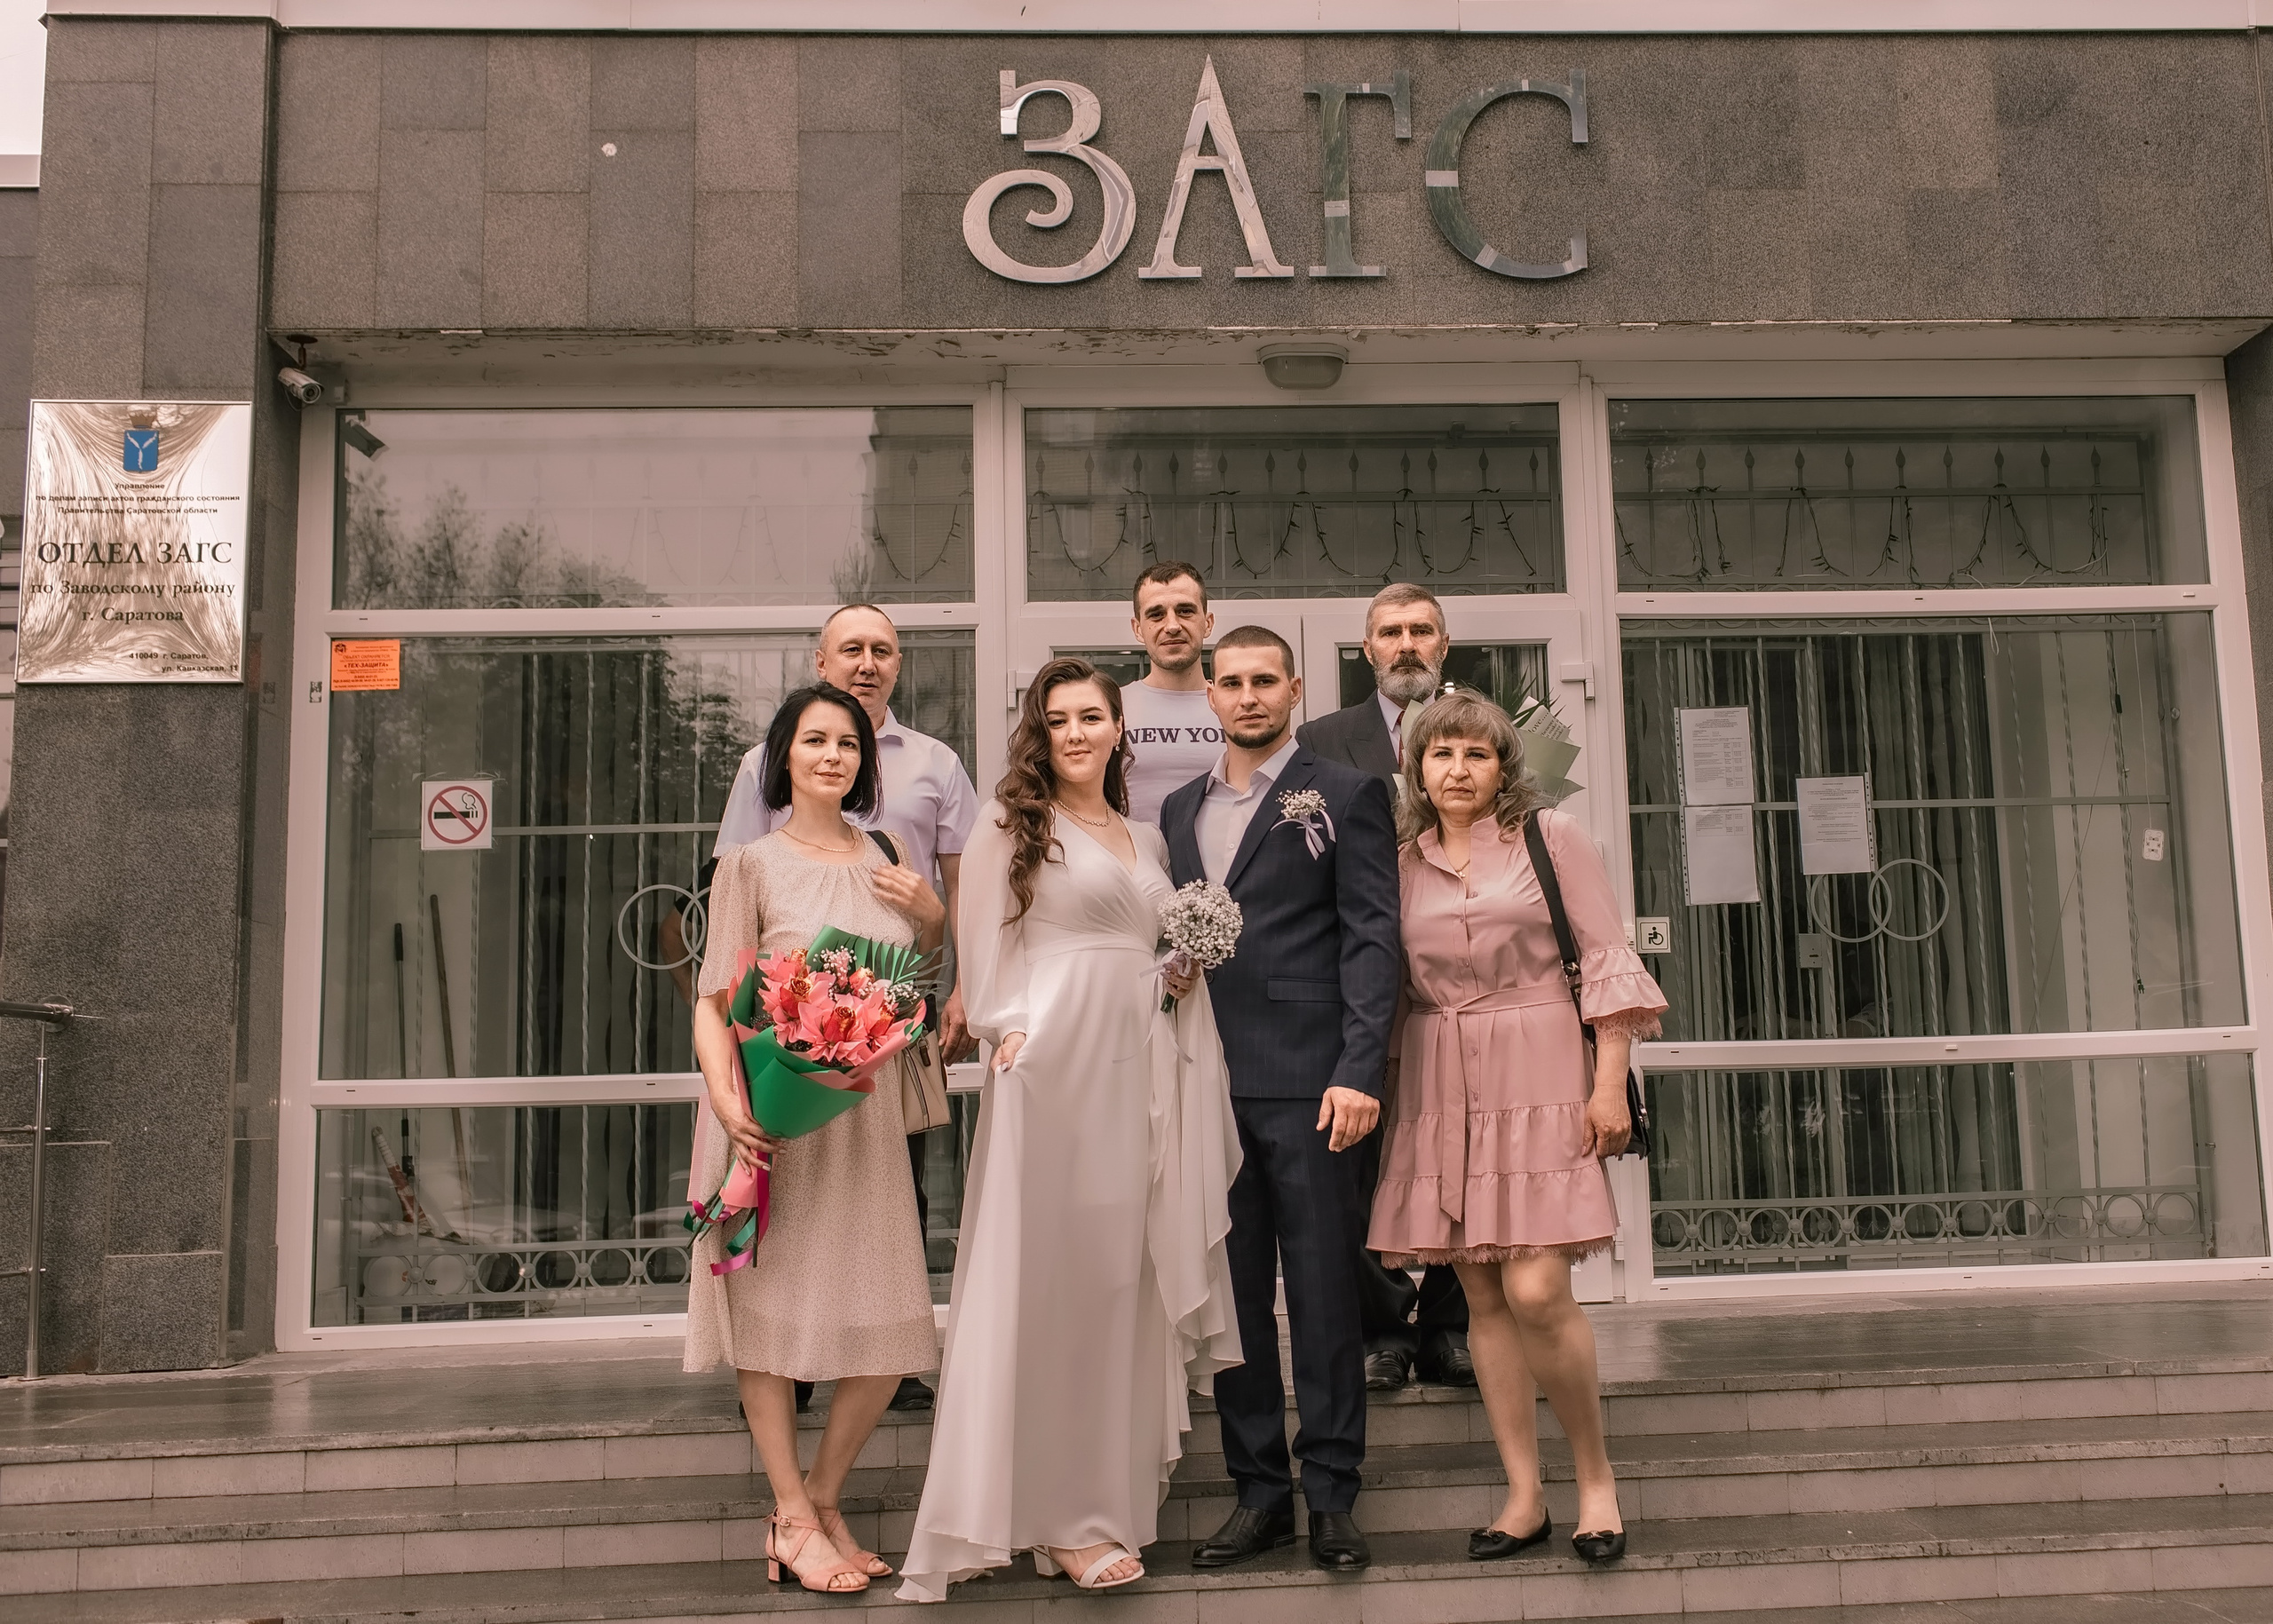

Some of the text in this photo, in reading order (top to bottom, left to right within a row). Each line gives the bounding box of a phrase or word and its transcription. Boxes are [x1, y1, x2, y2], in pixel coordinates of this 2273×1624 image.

[962, 54, 1588, 283] ЗАГС
[38, 542, 233, 568] ОТДЕЛ ЗАГС
[31, 580, 236, 598] по Заводскому району
[81, 607, 185, 624] г. Саратова
[1126, 727, 1181, 744] NEW
